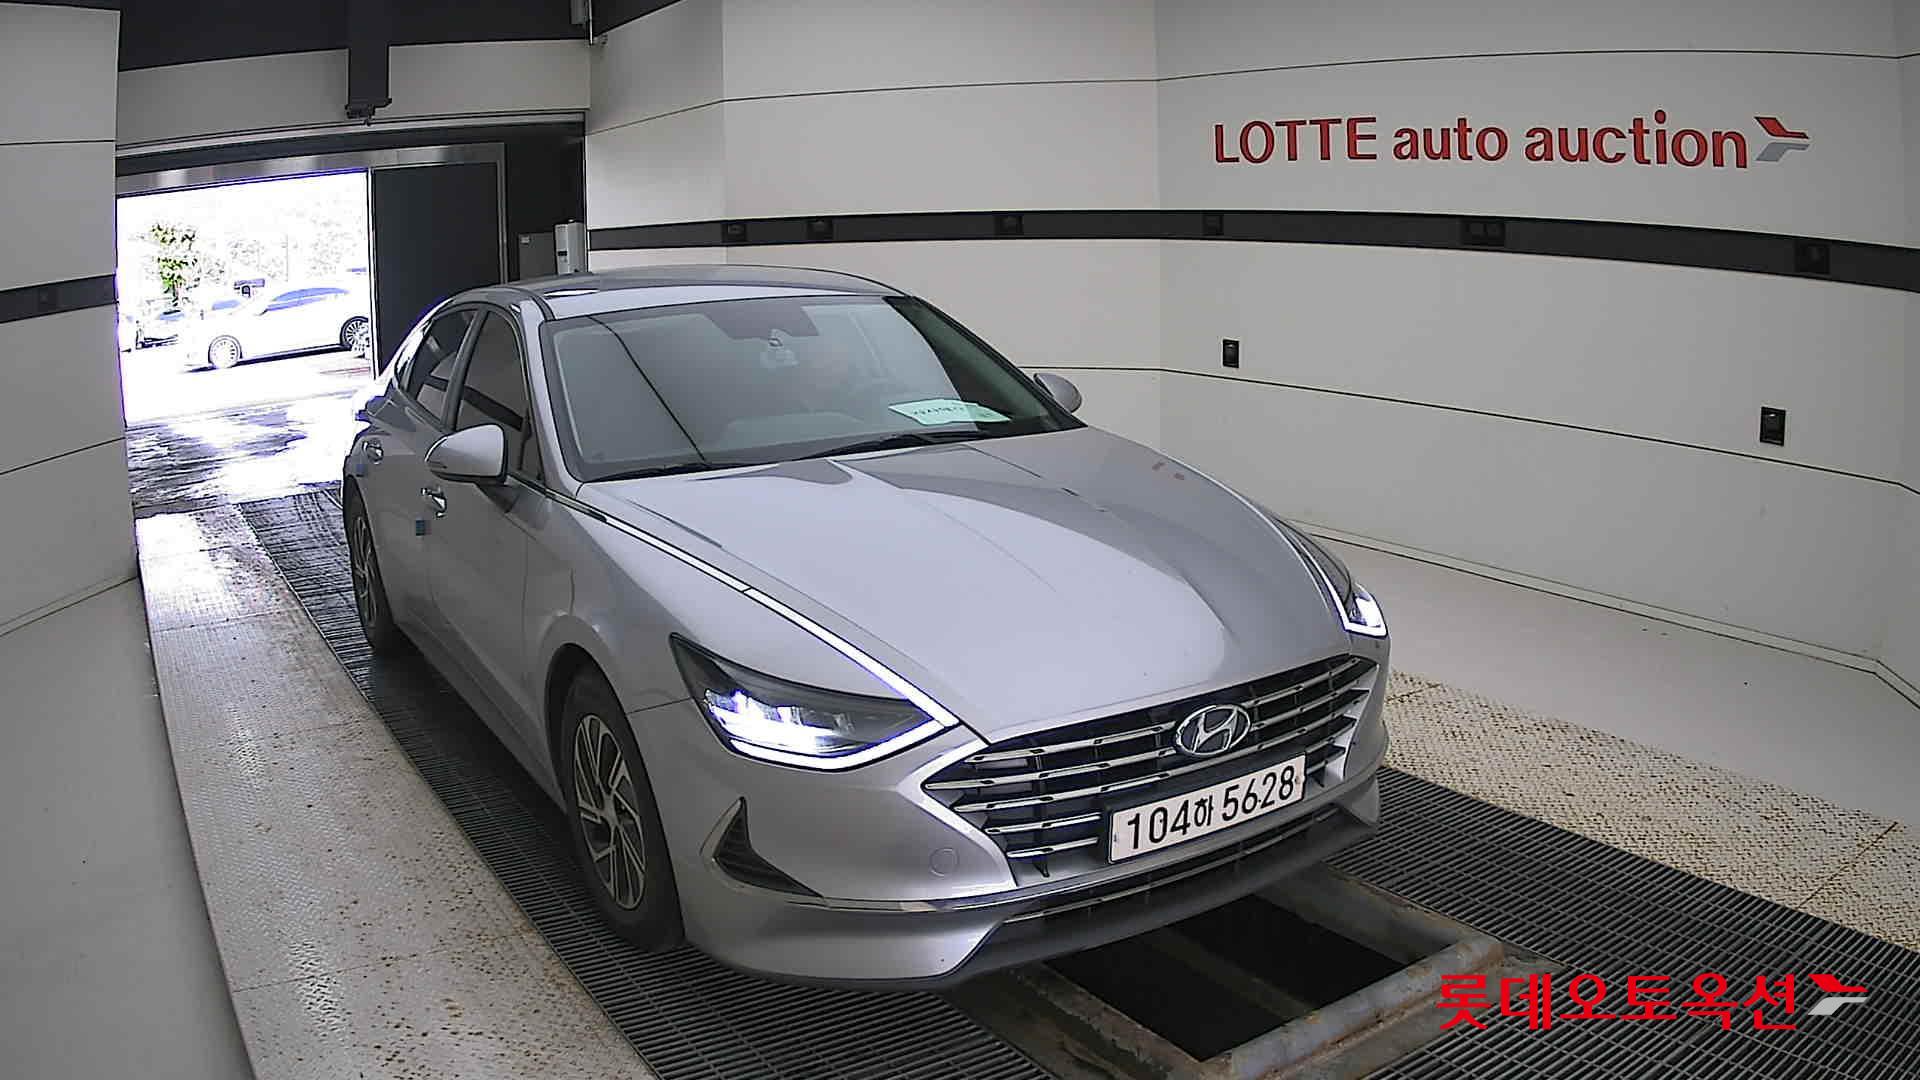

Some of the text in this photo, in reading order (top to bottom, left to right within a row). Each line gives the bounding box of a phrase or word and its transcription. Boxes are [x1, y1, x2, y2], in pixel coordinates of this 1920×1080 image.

[1214, 109, 1748, 169] LOTTE auto auction
[1127, 765, 1295, 850] 104하 5628
